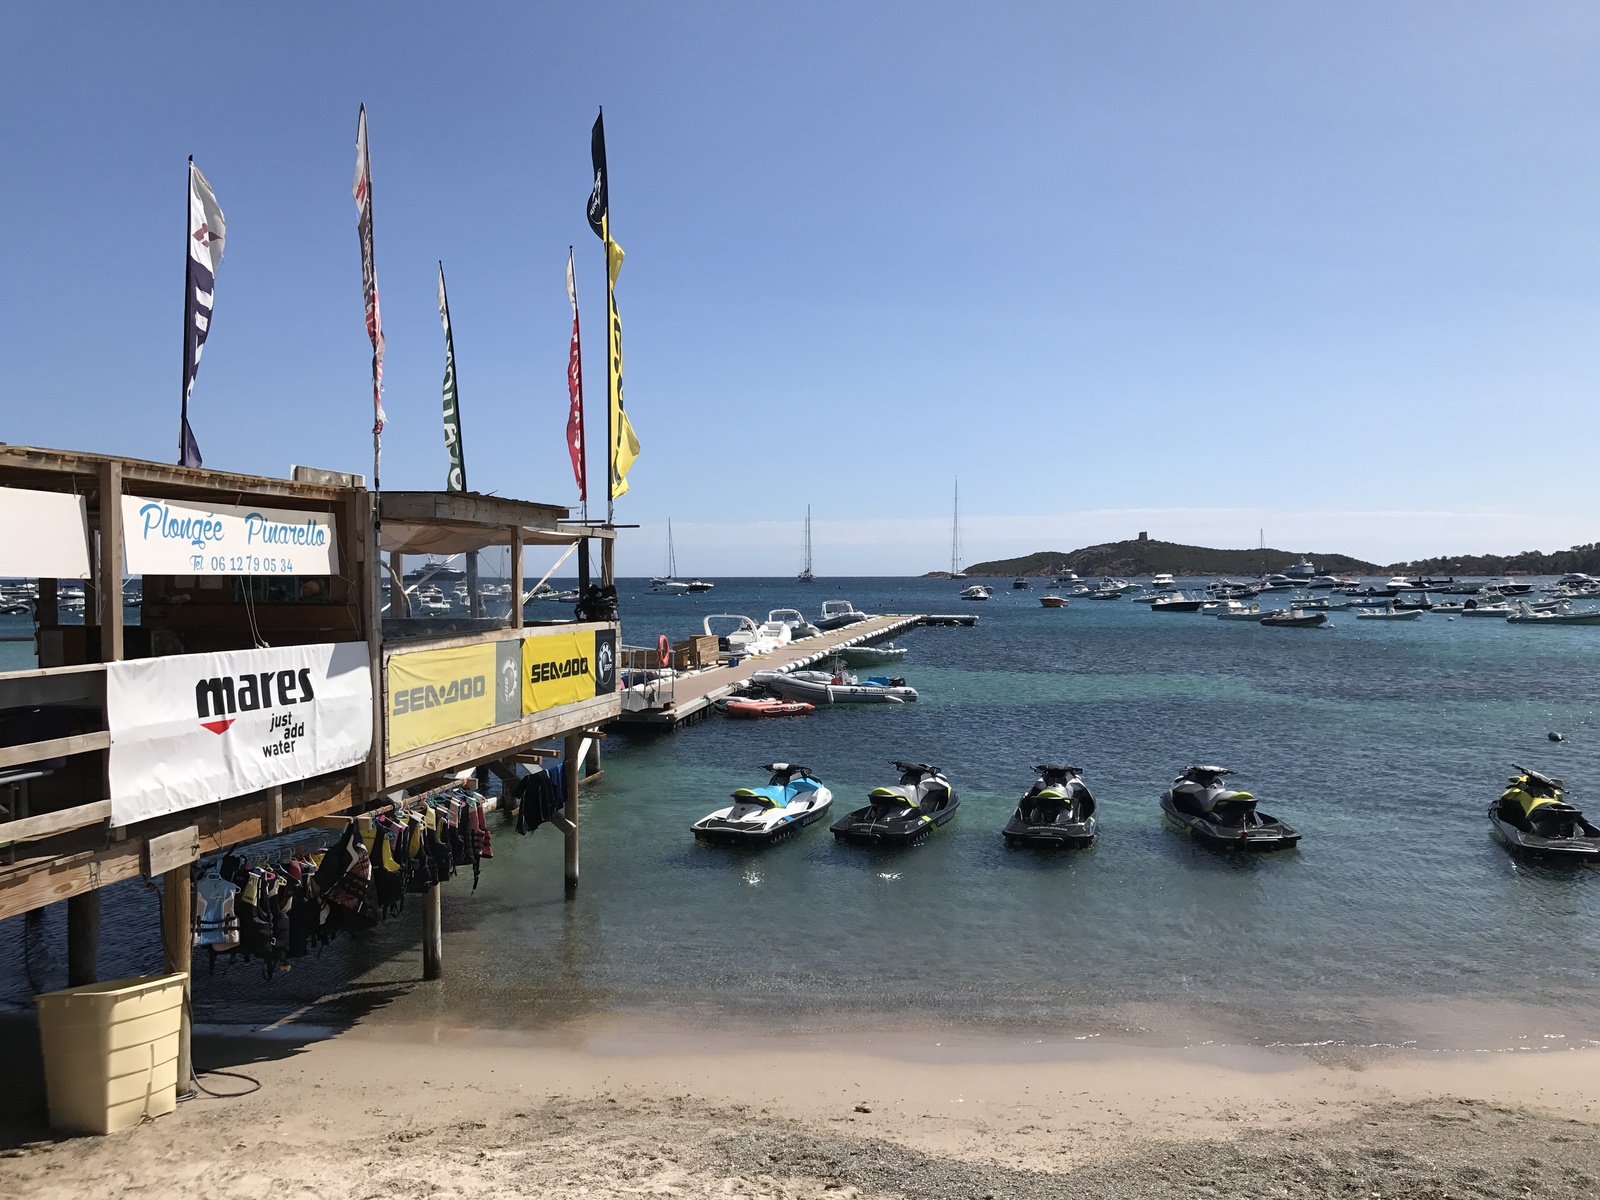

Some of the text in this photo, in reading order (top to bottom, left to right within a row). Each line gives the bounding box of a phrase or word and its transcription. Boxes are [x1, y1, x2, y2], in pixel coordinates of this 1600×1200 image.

[139, 503, 326, 550] Plongée Pinarello
[211, 556, 226, 571] 06
[230, 557, 243, 571] 12
[246, 554, 260, 572] 79
[263, 557, 277, 572] 05
[280, 558, 293, 572] 34
[196, 668, 314, 719] mares
[269, 711, 293, 733] just
[284, 721, 305, 740] add
[262, 739, 296, 758] water
